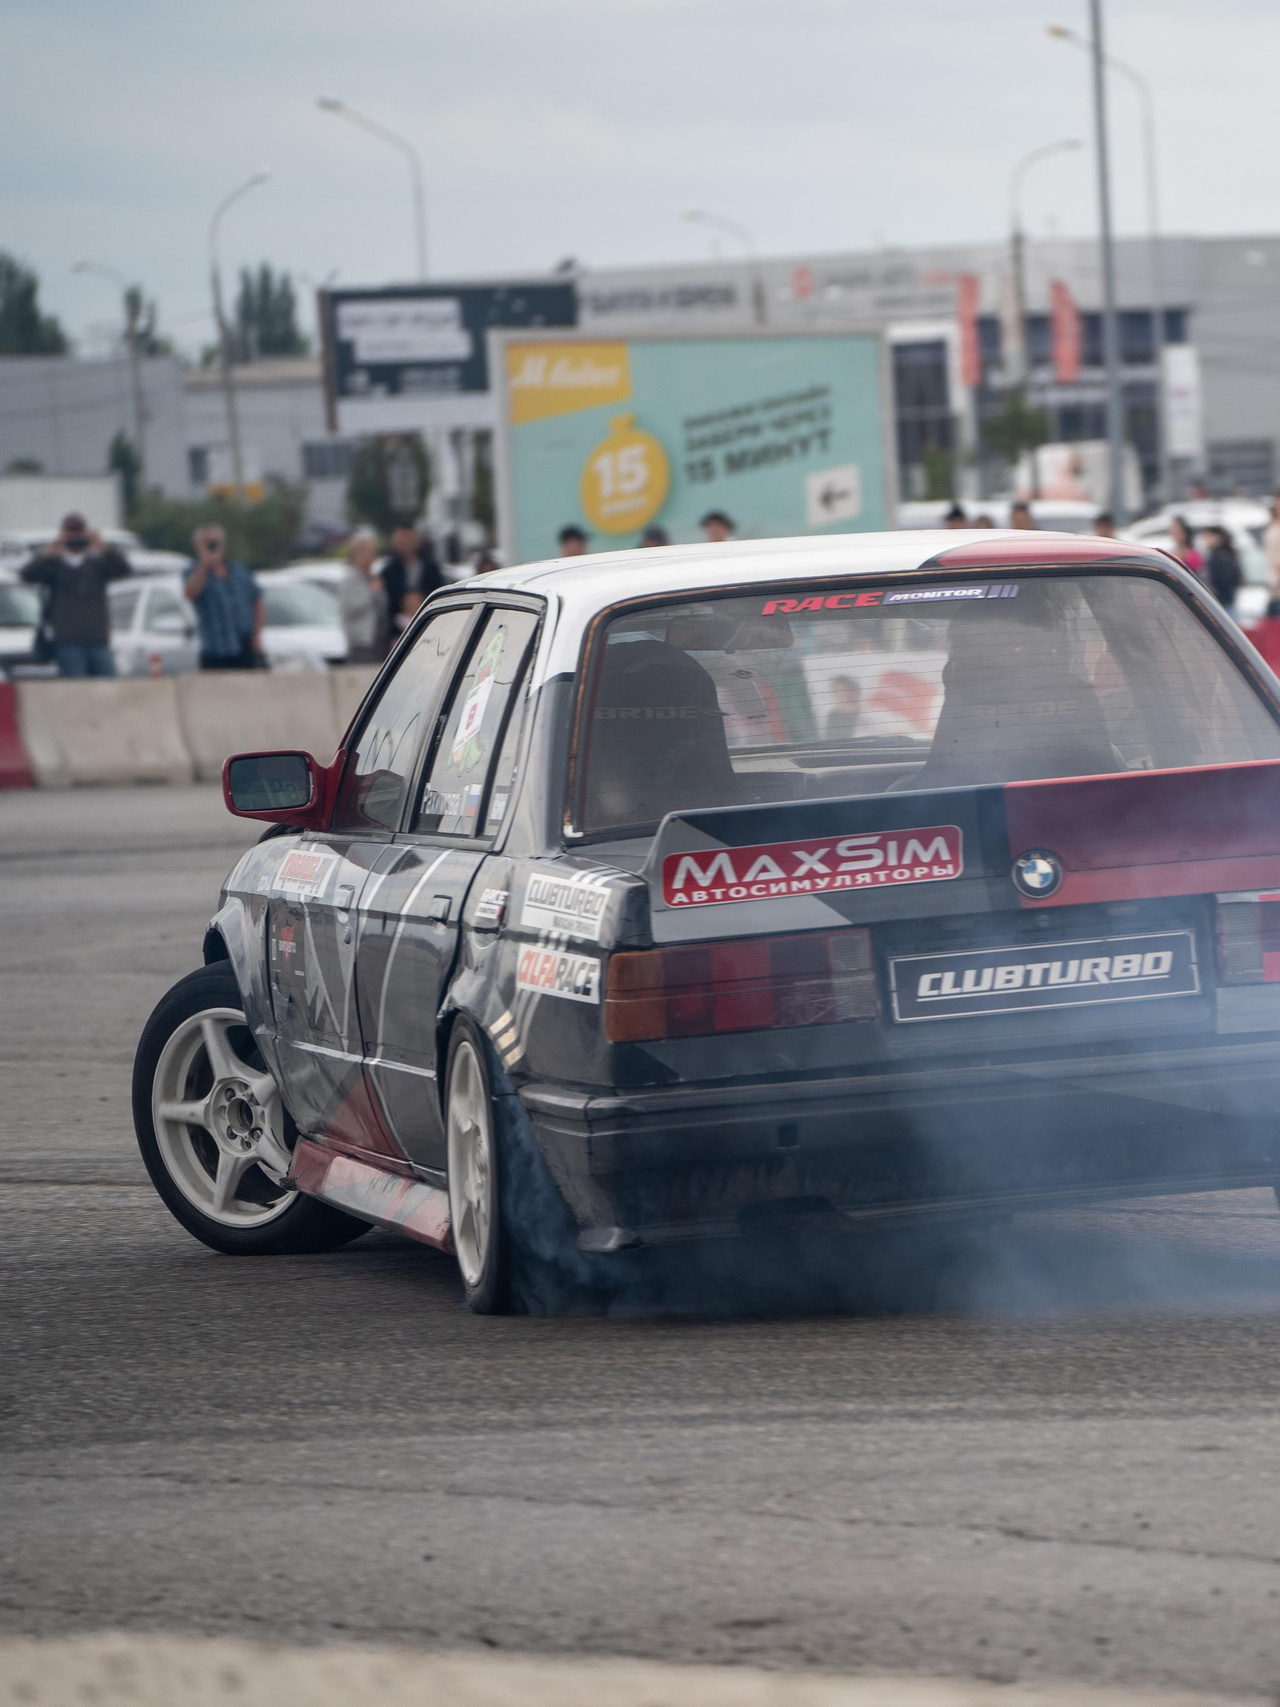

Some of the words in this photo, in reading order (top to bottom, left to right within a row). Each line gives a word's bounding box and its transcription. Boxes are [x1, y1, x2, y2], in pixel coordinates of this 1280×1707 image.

[593, 442, 646, 498] 15
[760, 591, 884, 616] RACE
[888, 588, 983, 602] MONITOR
[594, 705, 700, 721] BRIDE
[670, 863, 955, 905] АВТОСИМУЛЯТОРЫ
[916, 950, 1174, 998] CLUBTURBO
